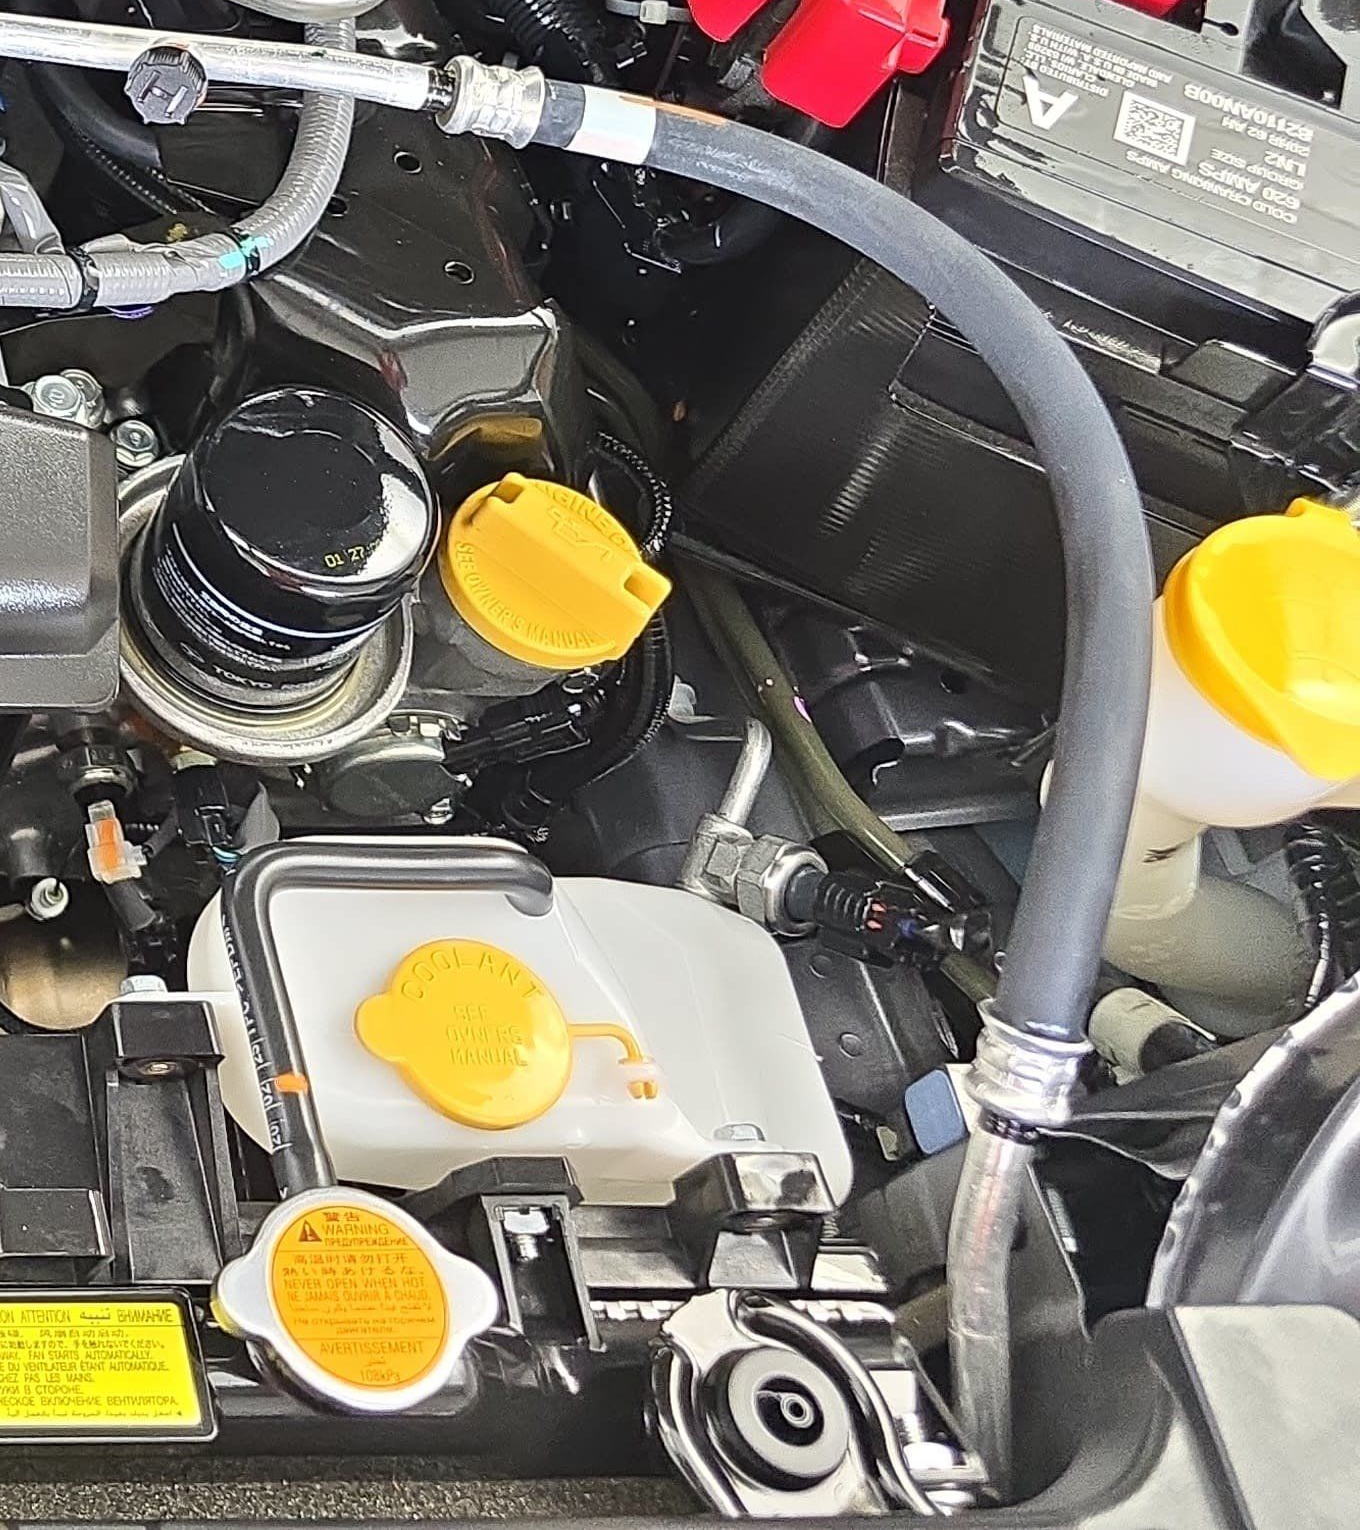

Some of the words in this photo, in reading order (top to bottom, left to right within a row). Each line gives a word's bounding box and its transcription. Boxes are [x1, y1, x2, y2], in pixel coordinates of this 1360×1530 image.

[1031, 23, 1093, 55] MATERIALS
[1048, 39, 1080, 58] WITH
[1038, 62, 1109, 99] DISTRIBUTED
[135, 69, 189, 118] H
[1022, 73, 1080, 131] A
[1124, 149, 1171, 176] AMPS
[1208, 147, 1247, 171] SIZE
[1260, 148, 1309, 178] LN2
[1169, 167, 1253, 208] CRANKING
[1195, 158, 1261, 196] AMPS
[1245, 161, 1305, 193] GROUP
[1260, 185, 1302, 212] 620
[1251, 199, 1298, 226] COLD
[324, 553, 345, 568] 01
[526, 625, 597, 650] MANUAL
[212, 664, 273, 690] TOKYO
[401, 946, 545, 1000] COOLANT
[453, 1004, 489, 1020] SEE
[450, 1047, 528, 1067] MANUAL
[322, 1223, 390, 1235] WARNING
[283, 1278, 321, 1290] NEVER
[326, 1278, 357, 1290] OPEN
[364, 1277, 398, 1289] WHEN
[20, 1309, 71, 1324] ATTENTION
[116, 1309, 174, 1323] ВНИМАНИЕ
[28, 1350, 45, 1360] FAN
[48, 1350, 80, 1360] STARTS
[320, 1340, 424, 1356] AVERTISSEMENT
[8, 1362, 20, 1372] DU
[22, 1362, 77, 1372] VENTILATEUR
[24, 1373, 41, 1383] PAS
[45, 1373, 61, 1383] LES
